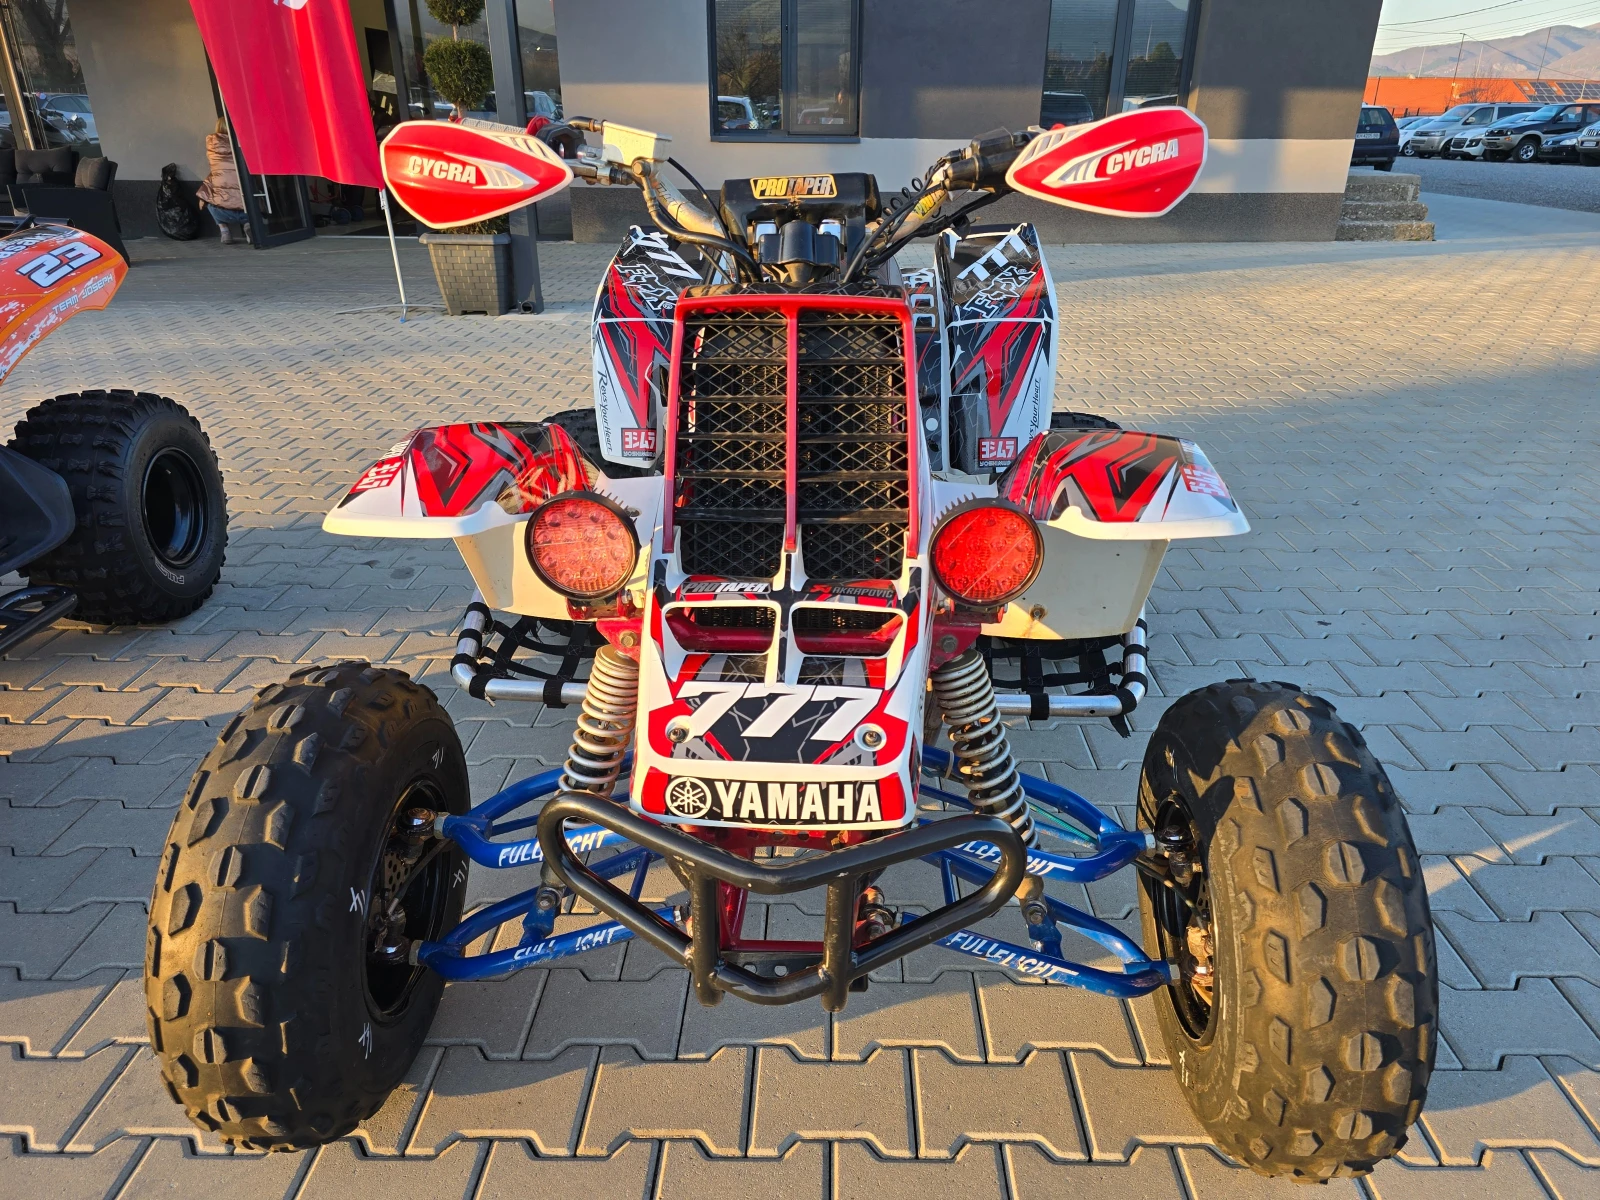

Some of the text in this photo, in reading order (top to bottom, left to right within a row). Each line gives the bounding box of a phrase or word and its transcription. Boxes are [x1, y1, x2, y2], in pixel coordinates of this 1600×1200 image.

[408, 155, 477, 185] CYCRA
[1105, 138, 1179, 175] CYCRA
[755, 176, 833, 197] PROTAPER
[15, 241, 103, 288] 23
[956, 234, 1027, 281] 777
[52, 273, 114, 315] TEAM JOSEPH
[981, 440, 1015, 459] ヨシムラ
[682, 582, 769, 595] PROTAPER
[676, 680, 884, 742] 777
[714, 781, 882, 822] YAMAHA
